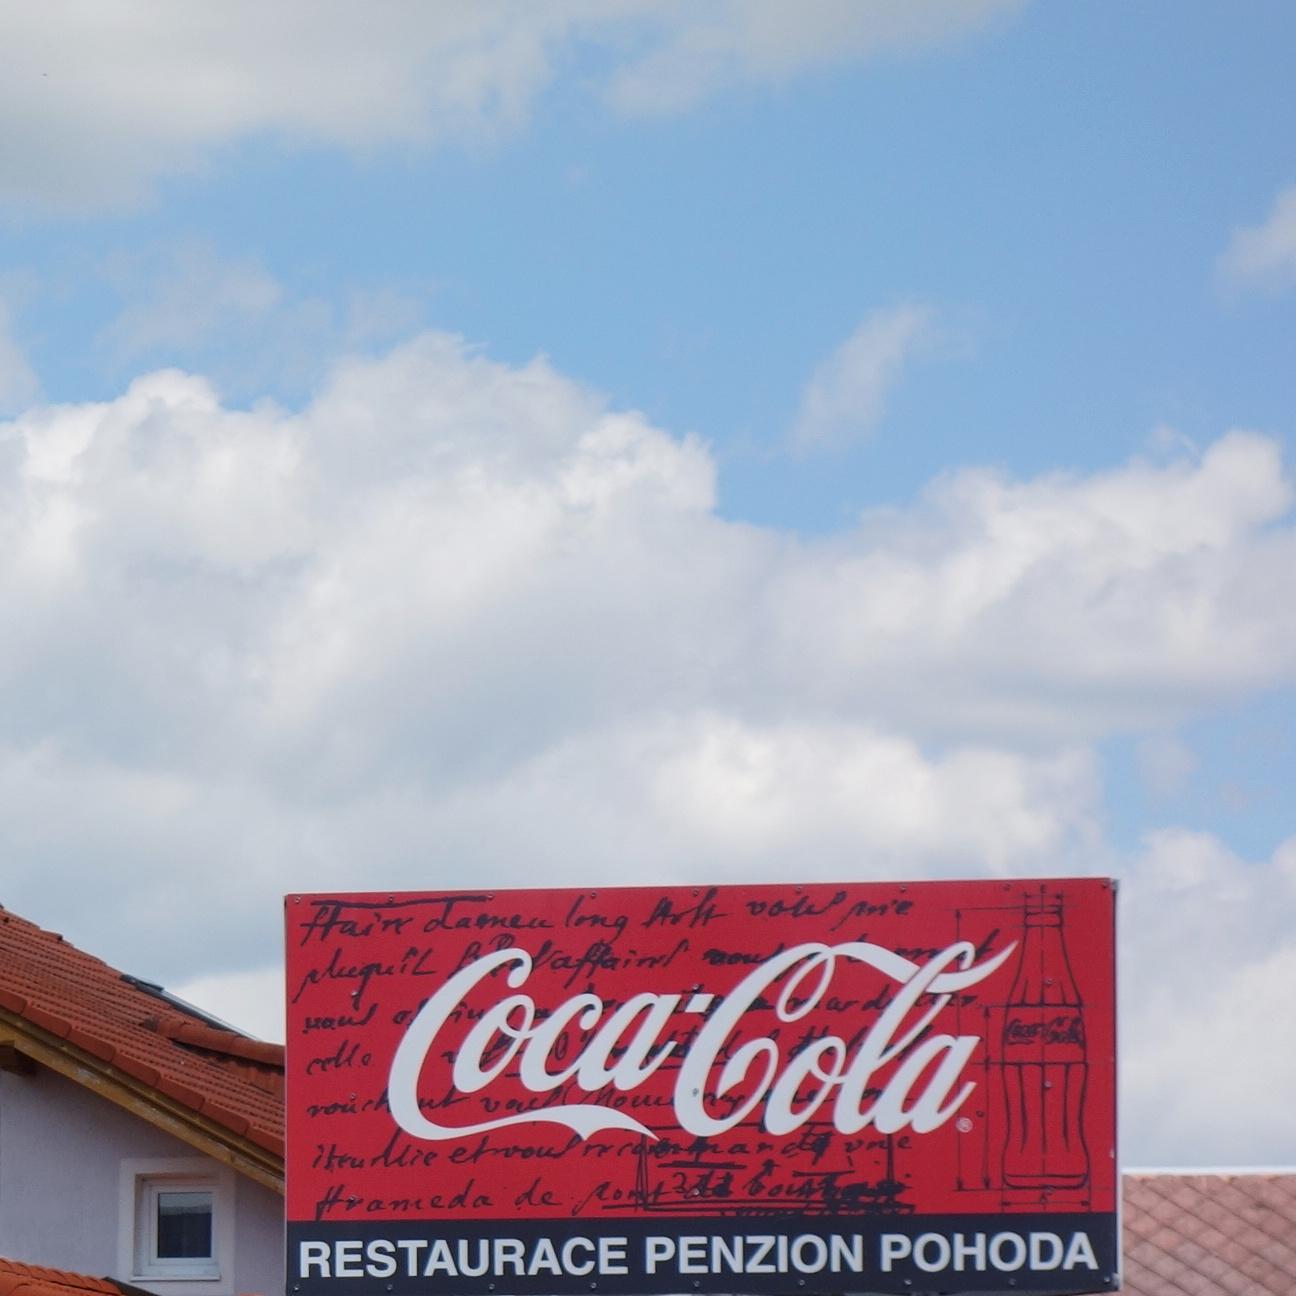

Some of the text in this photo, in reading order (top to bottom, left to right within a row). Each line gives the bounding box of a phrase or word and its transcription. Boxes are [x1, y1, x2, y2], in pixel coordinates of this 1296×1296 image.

[389, 941, 1018, 1141] Coca-Cola
[299, 1231, 1100, 1279] RESTAURACE PENZION POHODA
